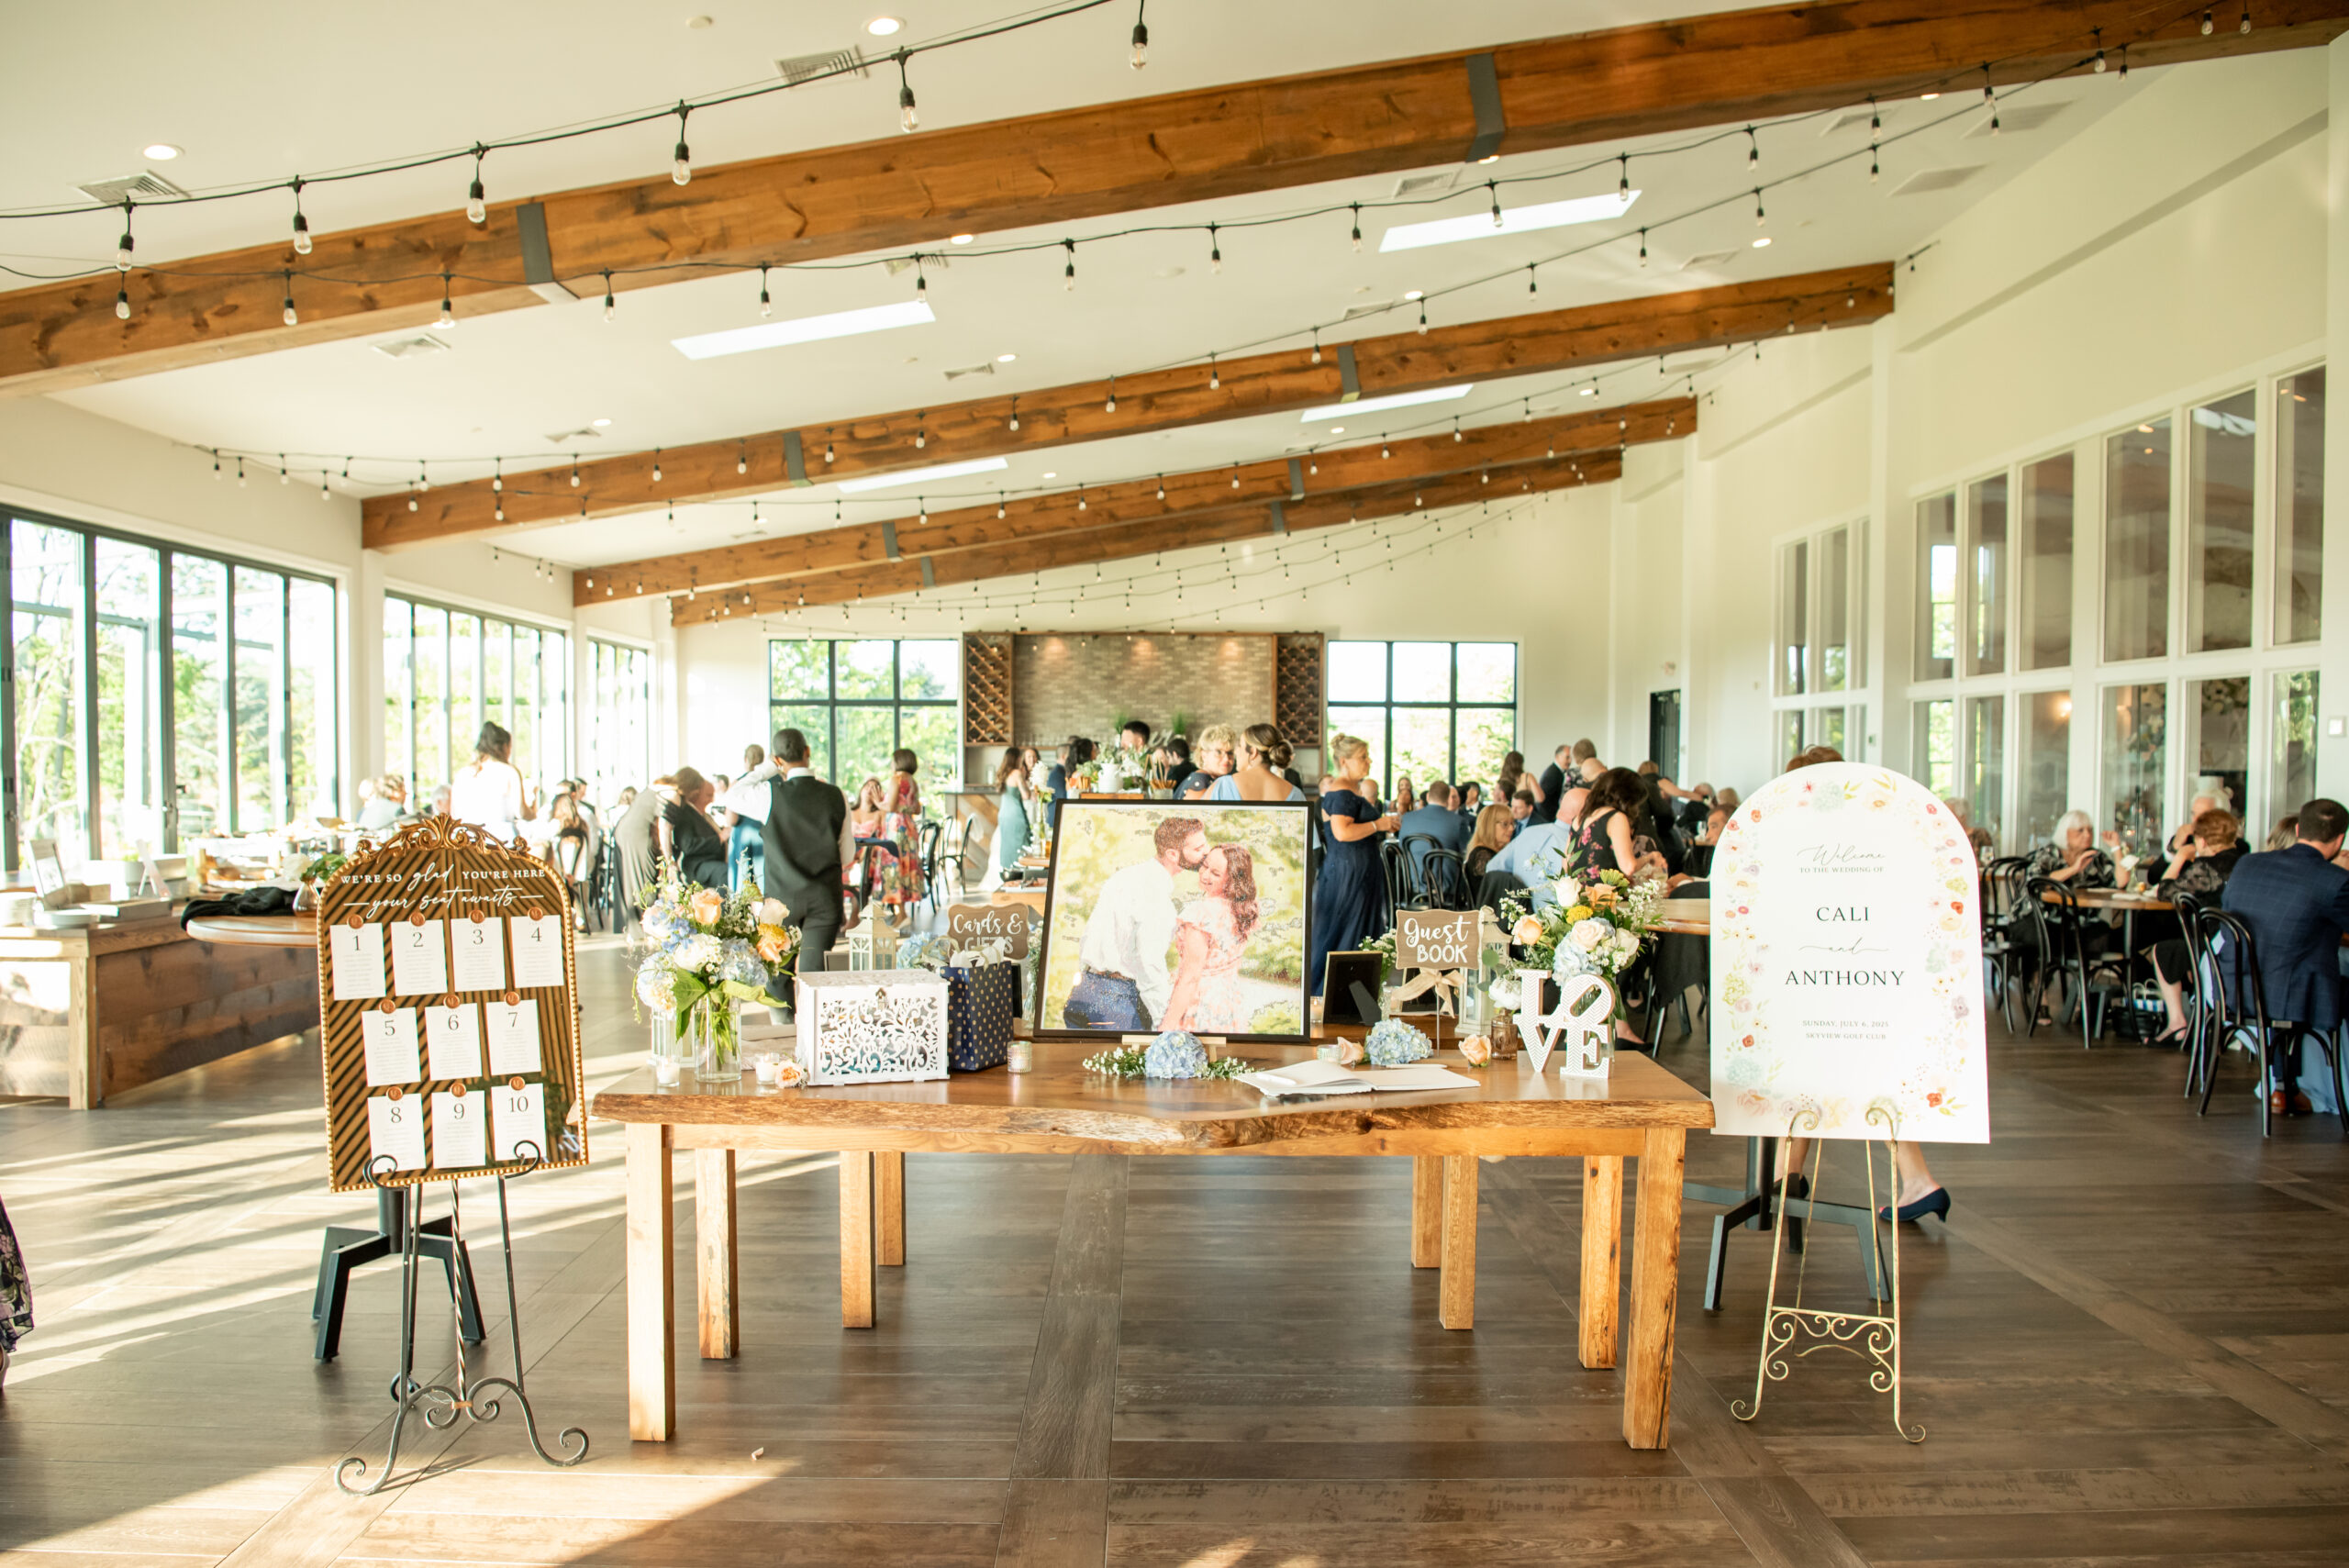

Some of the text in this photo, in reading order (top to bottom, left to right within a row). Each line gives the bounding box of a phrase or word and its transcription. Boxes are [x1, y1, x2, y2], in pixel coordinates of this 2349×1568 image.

[1797, 843, 1885, 865] Welcome
[340, 862, 545, 891] WE'RE SO glad YOU'RE HERE
[366, 884, 522, 918] your seat awaits
[1816, 906, 1869, 921] CALI
[953, 911, 1023, 935] Cards &
[352, 935, 361, 951] 1
[412, 931, 424, 948] 2
[473, 929, 484, 945] 3
[530, 927, 542, 942] 4
[1417, 944, 1468, 963] BOOK
[1785, 970, 1904, 985] ANTHONY
[384, 1019, 395, 1036] 5
[448, 1015, 459, 1030] 6
[507, 1012, 518, 1028] 7
[453, 1103, 465, 1119] 9
[509, 1096, 529, 1113] 10
[390, 1106, 402, 1123] 8
